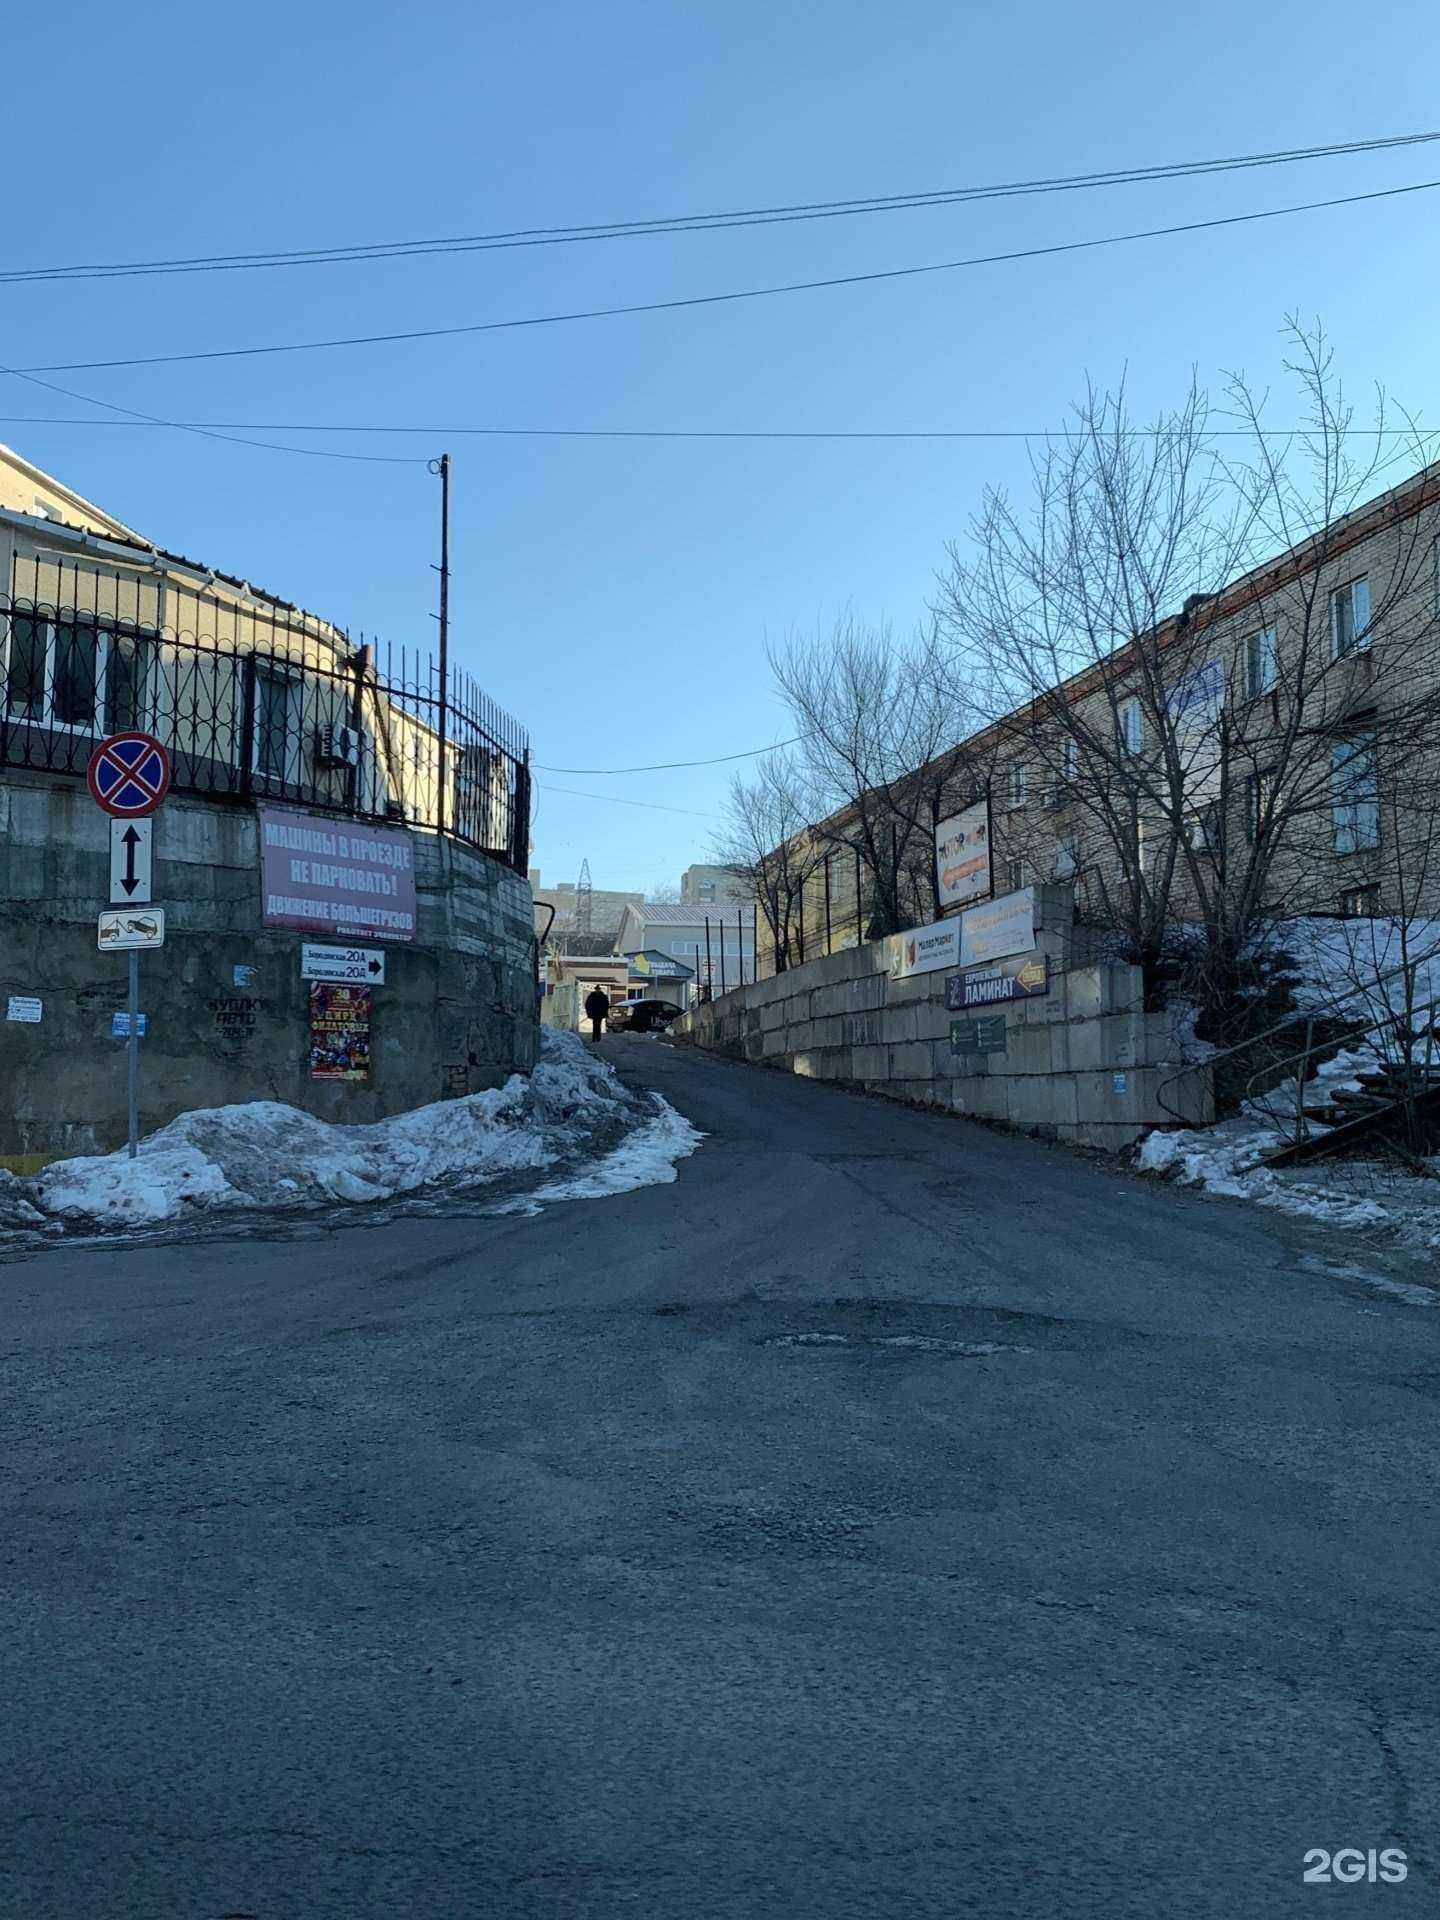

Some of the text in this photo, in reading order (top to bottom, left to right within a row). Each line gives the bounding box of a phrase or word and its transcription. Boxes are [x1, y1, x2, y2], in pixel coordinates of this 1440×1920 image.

[265, 823, 410, 871] МАШИНЫ В ПРОЕЗДЕ
[290, 860, 398, 896] НЕ ПАРКОВАТЬ!
[267, 894, 327, 919] ДВИЖЕНИЕ
[964, 976, 1015, 1004] ЛАМИНАТ
